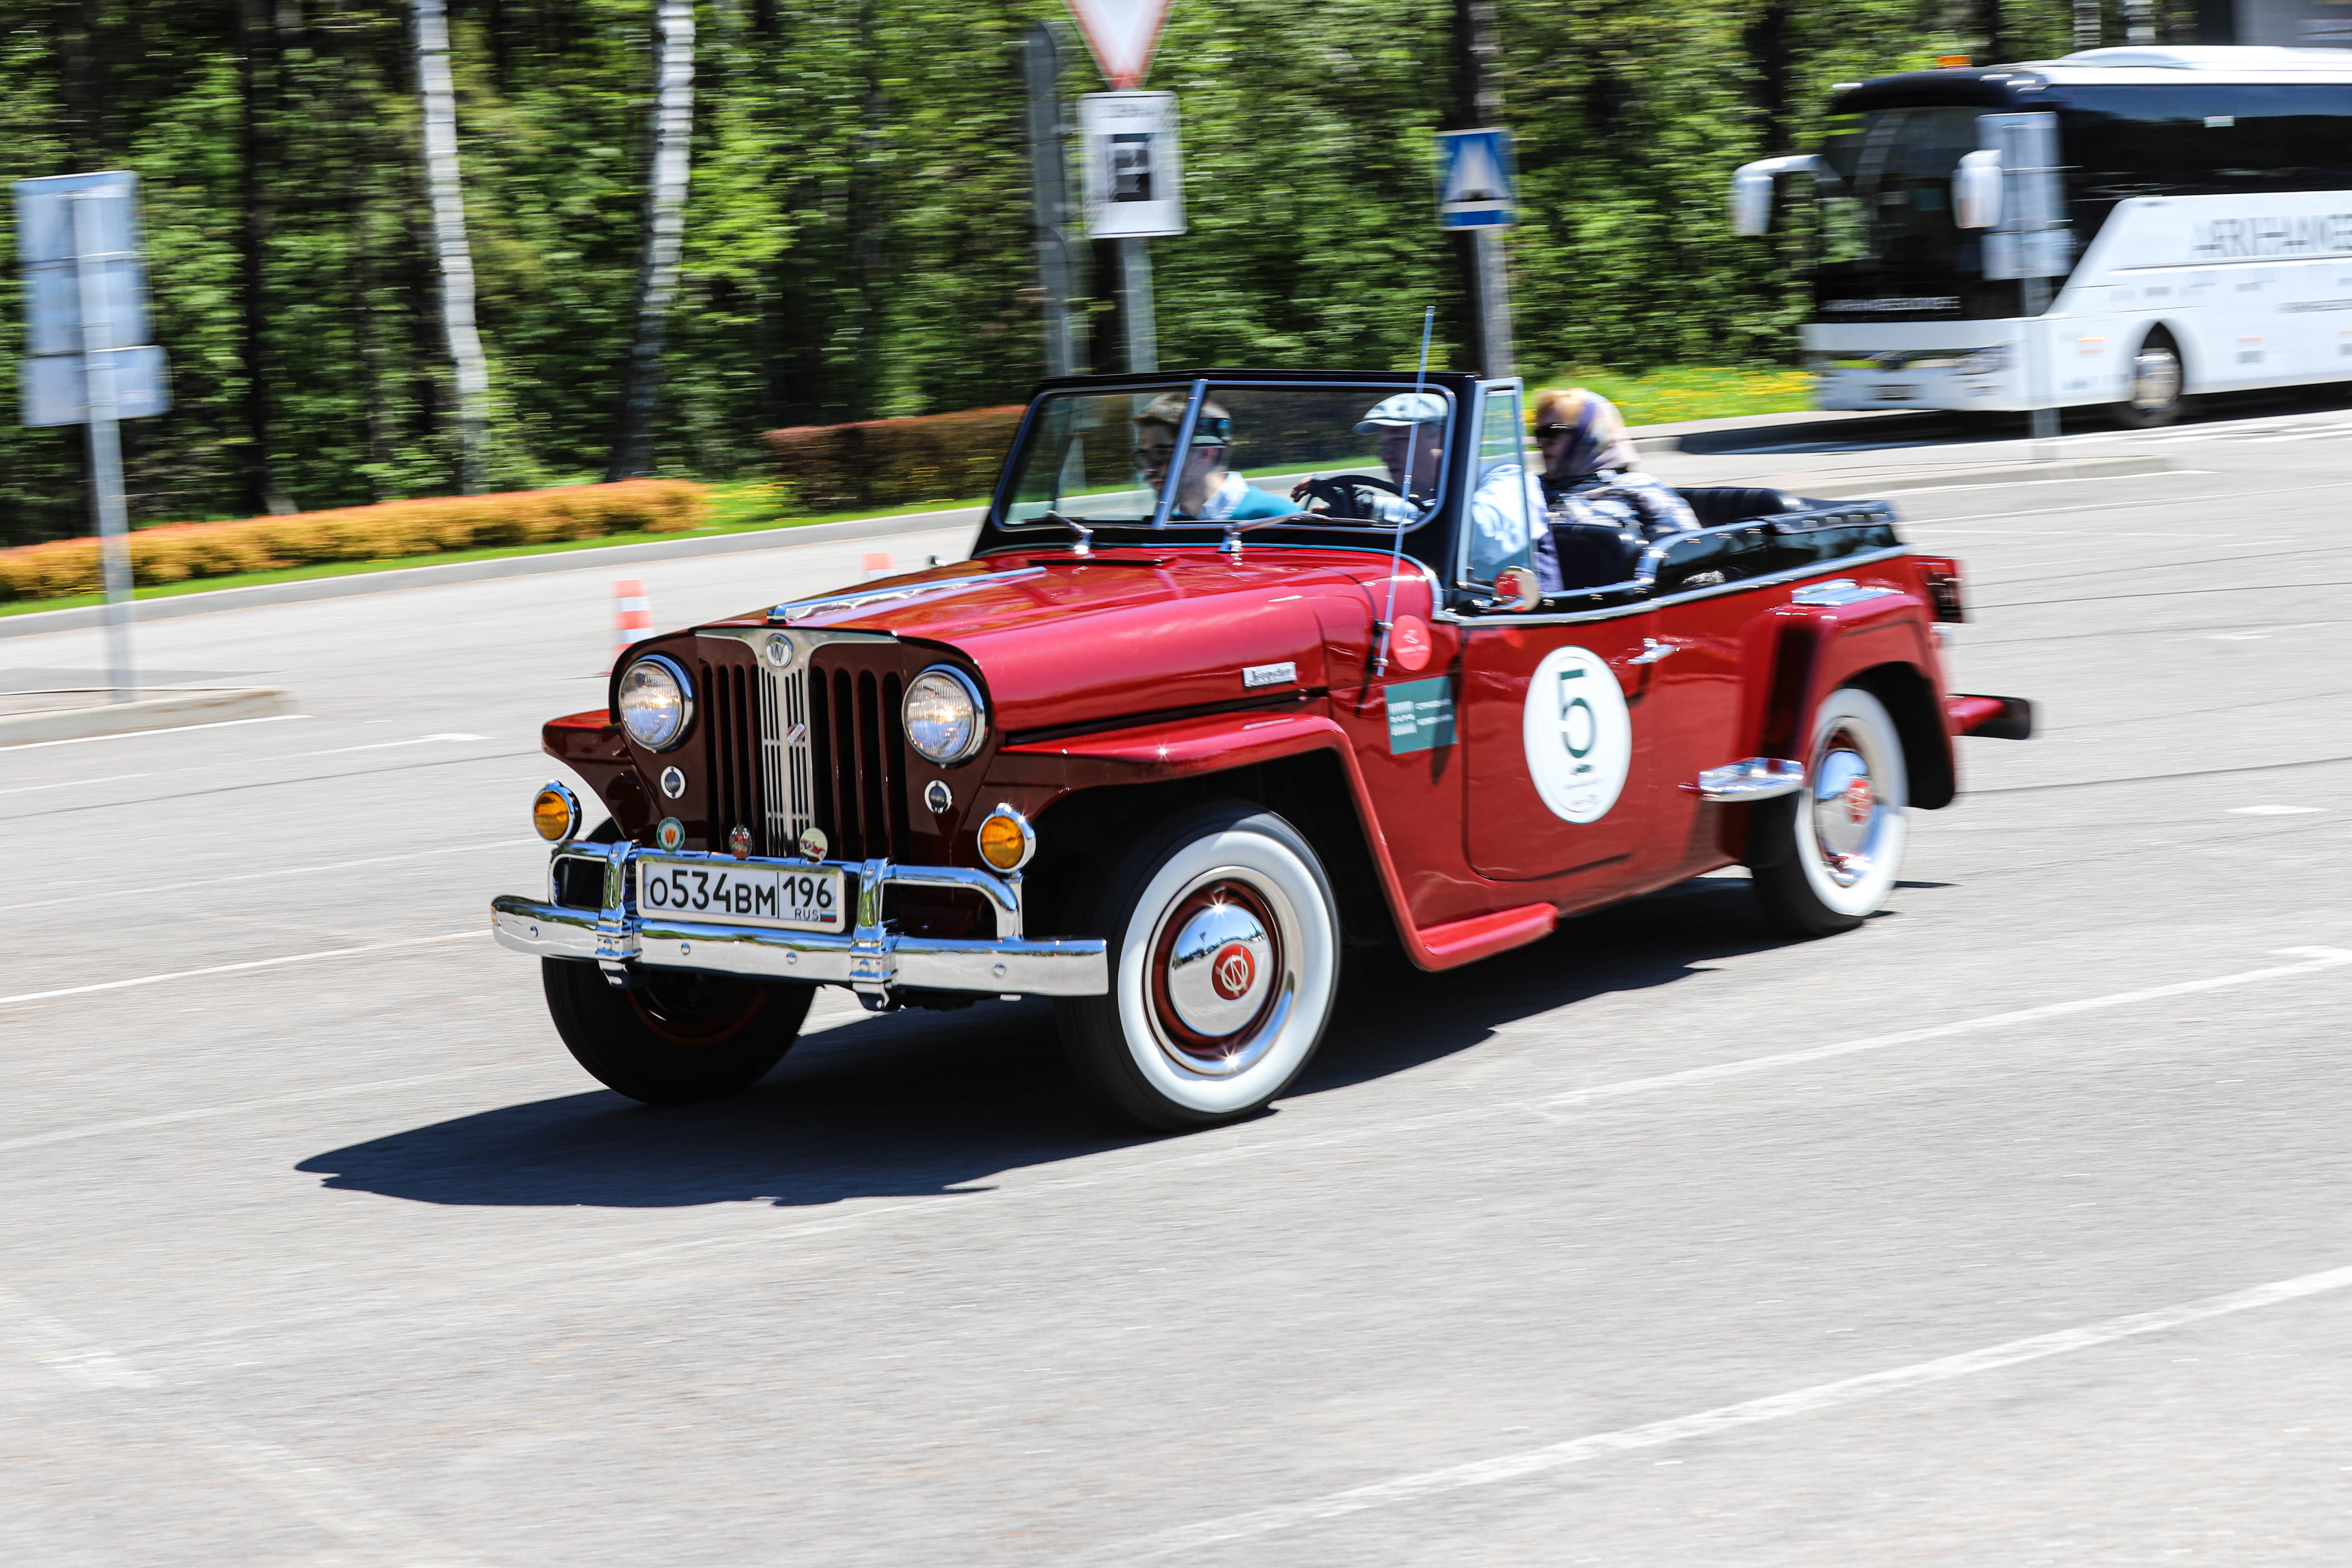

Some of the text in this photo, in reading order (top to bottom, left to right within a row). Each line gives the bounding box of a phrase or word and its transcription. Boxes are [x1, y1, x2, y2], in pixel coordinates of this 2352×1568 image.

[1557, 669, 1598, 758] 5
[650, 869, 831, 916] O534BM 196
[795, 908, 819, 921] RUS
